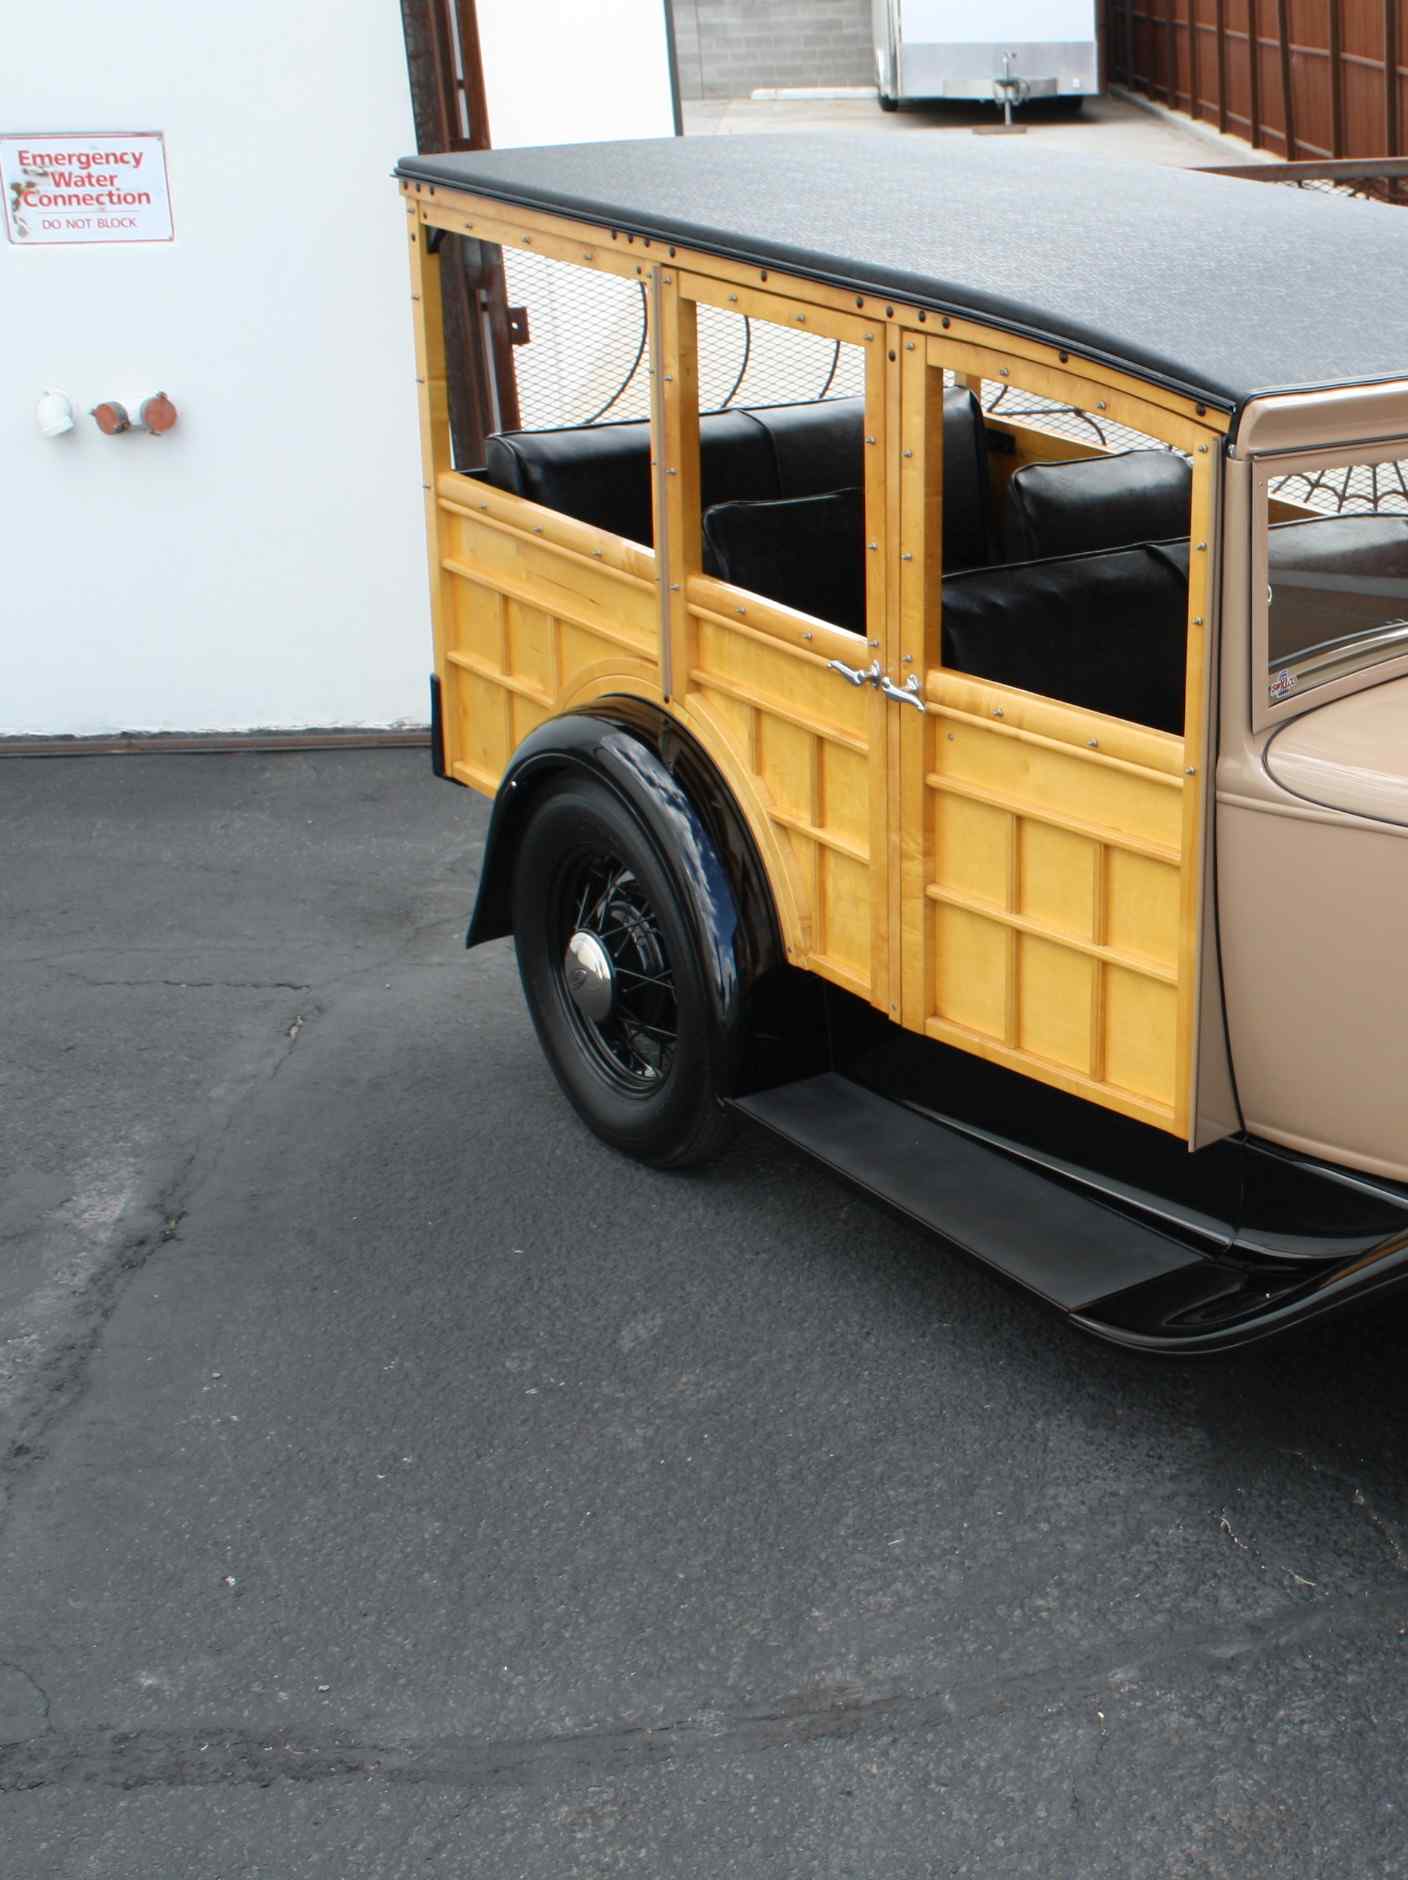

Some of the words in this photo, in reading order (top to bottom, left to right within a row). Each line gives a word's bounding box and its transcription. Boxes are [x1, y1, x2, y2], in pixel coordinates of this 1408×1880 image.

[18, 149, 144, 169] Emergency
[50, 171, 118, 188] Water
[22, 189, 151, 207] Connection
[42, 219, 62, 230] DO
[66, 218, 91, 229] NOT
[97, 217, 136, 229] BLOCK
